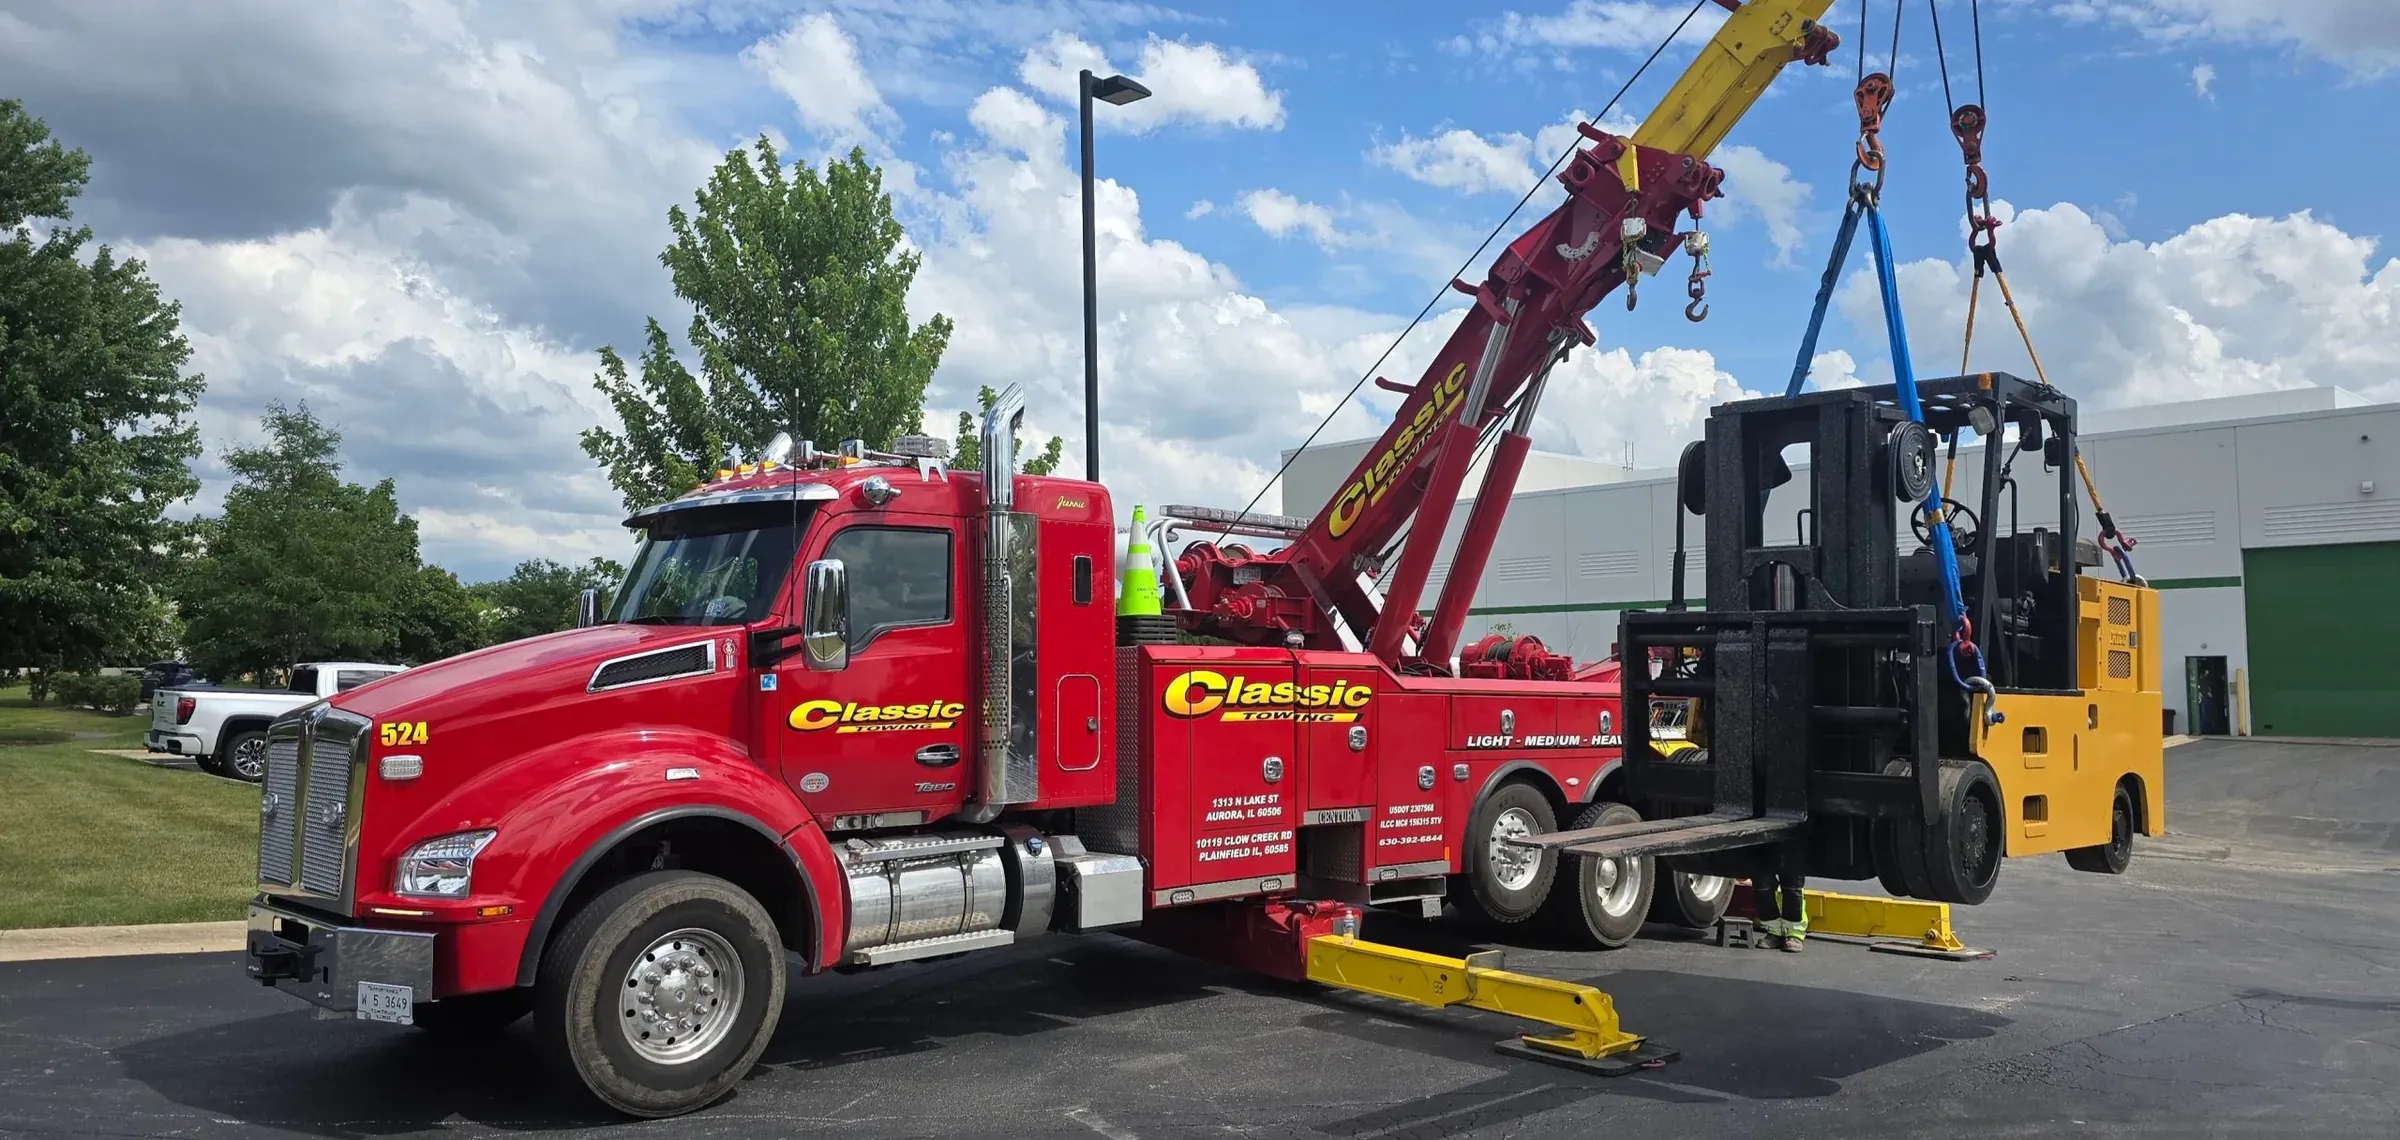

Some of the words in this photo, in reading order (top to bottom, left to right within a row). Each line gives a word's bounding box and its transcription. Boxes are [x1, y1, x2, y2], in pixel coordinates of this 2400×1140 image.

[1328, 362, 1467, 540] Classic
[1385, 411, 1449, 489] TOWING
[1162, 669, 1373, 719] Classic
[787, 699, 965, 732] Classic
[1243, 711, 1334, 723] TOWING
[381, 721, 429, 747] 524
[855, 723, 933, 732] TOWING
[1467, 735, 1513, 747] LIGHT
[1524, 735, 1580, 747] MEDIUM
[1591, 734, 1623, 746] HEAV
[1212, 797, 1233, 808] 1313
[1235, 796, 1242, 806] N
[1243, 794, 1266, 806] LAKE
[1267, 793, 1279, 804] ST
[1205, 809, 1245, 822] AURORA,
[1247, 808, 1255, 818] IL
[1257, 806, 1282, 817] 60506
[1319, 808, 1358, 824] CENTURY
[1389, 805, 1410, 815] USDOT
[1380, 819, 1394, 829] ILCC
[1196, 837, 1222, 849] 10119
[1224, 834, 1250, 846] CLOW
[1251, 832, 1279, 843] CREEK
[1280, 830, 1292, 840] RD
[1379, 834, 1443, 846] 630-392-6844
[1198, 848, 1250, 862] PLAINFIELD
[1252, 846, 1262, 857] IL,
[1264, 843, 1289, 855] 60585
[385, 996, 407, 1010] 3649
